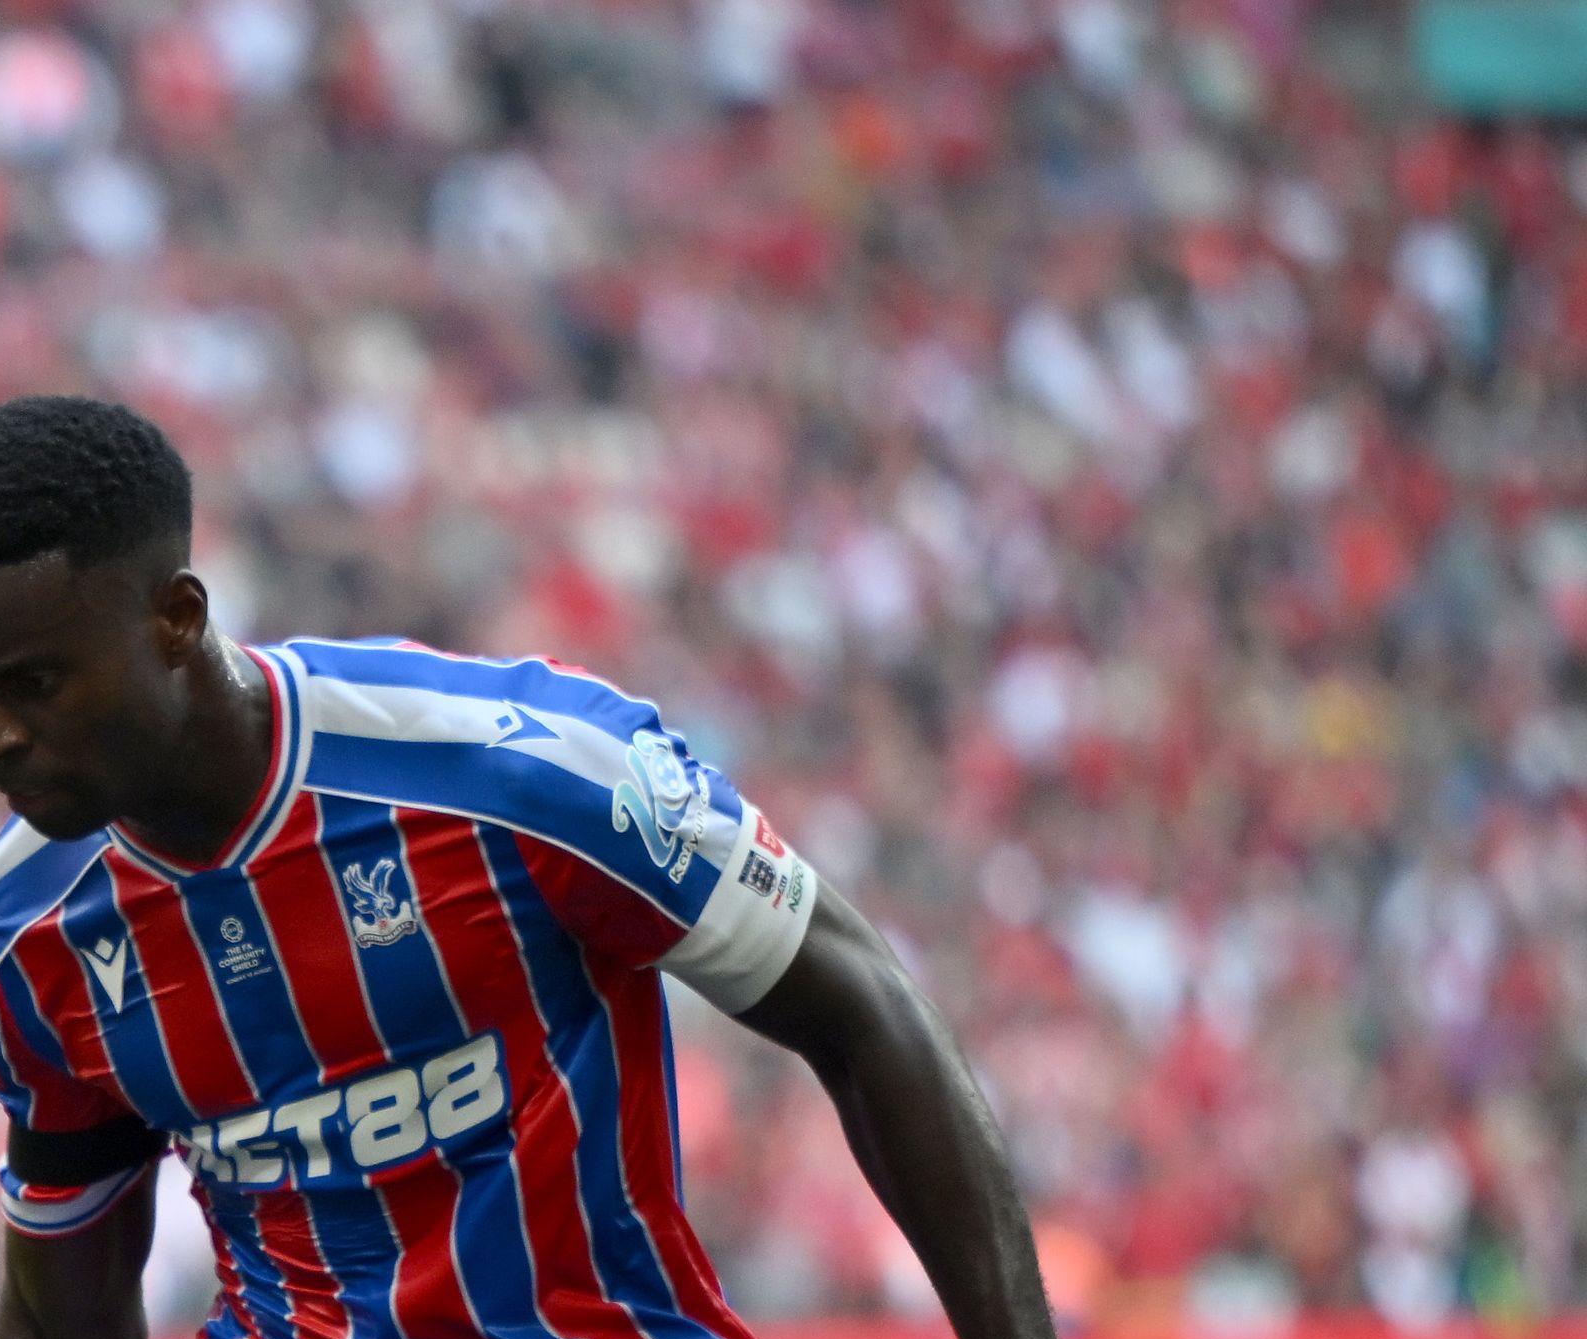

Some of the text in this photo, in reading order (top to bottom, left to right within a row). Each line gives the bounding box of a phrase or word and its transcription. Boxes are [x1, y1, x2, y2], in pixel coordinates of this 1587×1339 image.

[218, 948, 264, 968] COMMUNITY
[226, 946, 242, 958] THE
[231, 959, 258, 973] SHIELD
